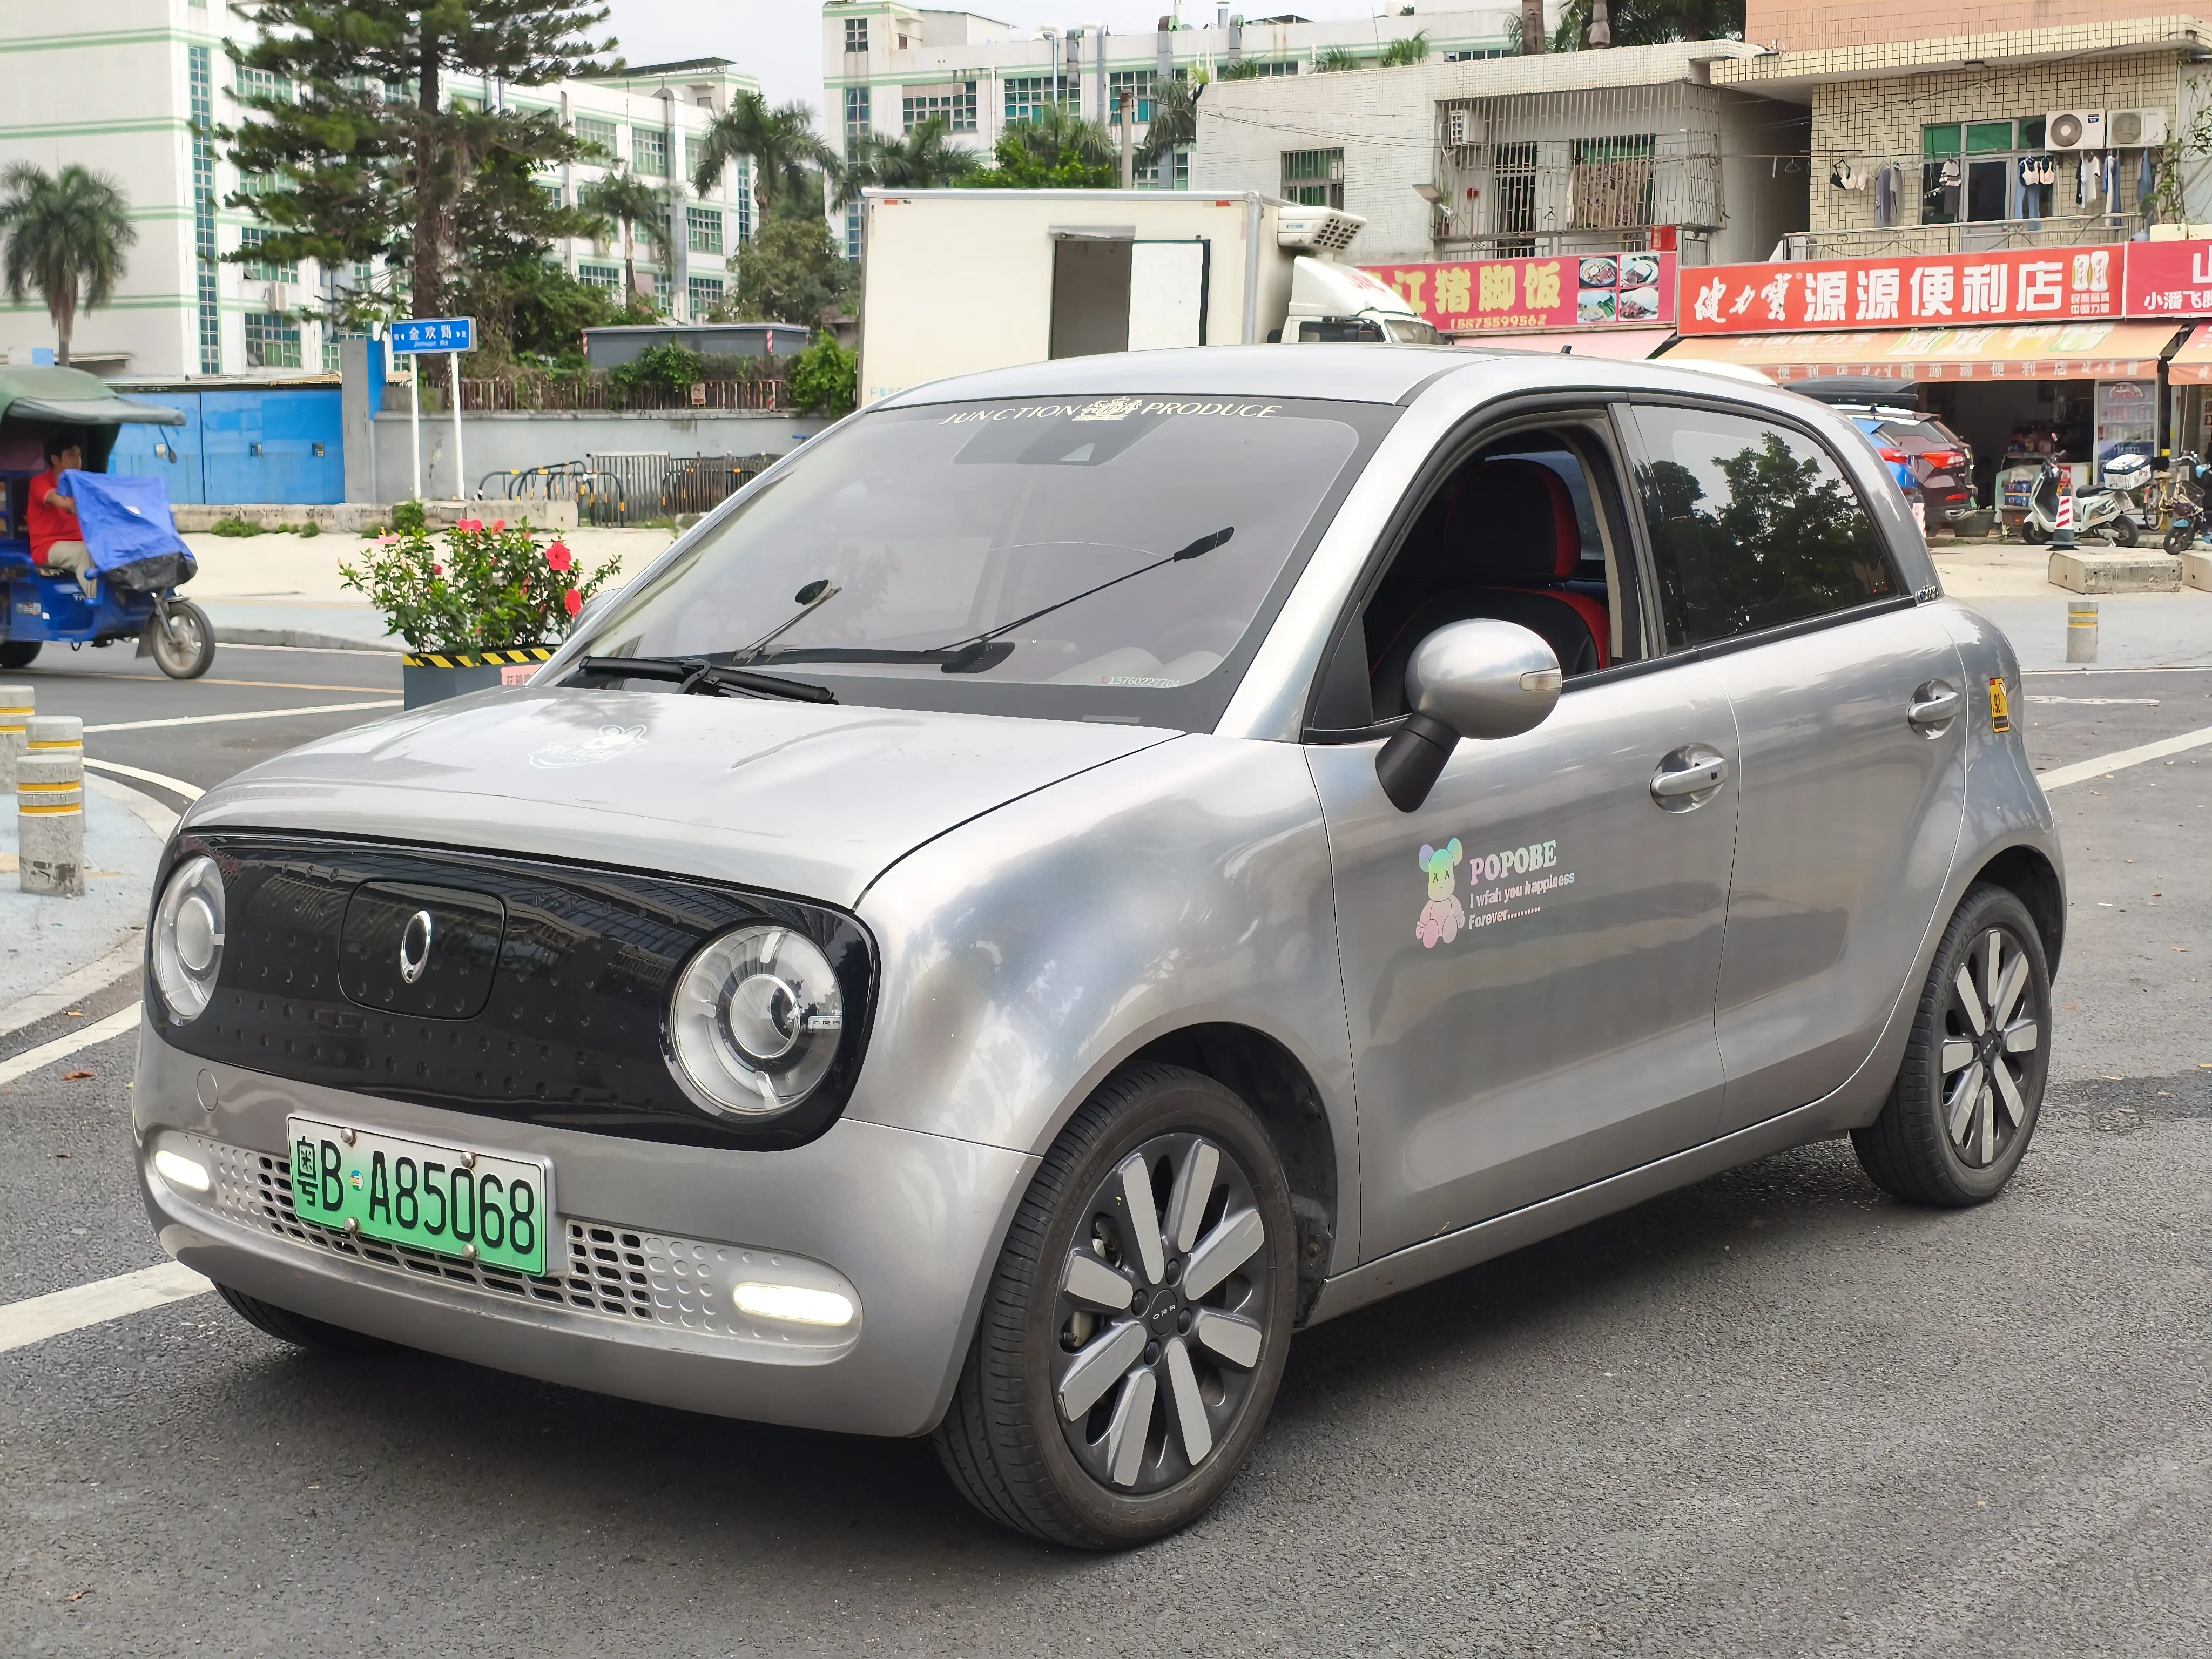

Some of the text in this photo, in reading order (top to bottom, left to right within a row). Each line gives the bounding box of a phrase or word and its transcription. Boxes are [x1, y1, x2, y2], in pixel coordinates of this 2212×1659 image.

[1372, 261, 1561, 314] 江猪脚饭
[1804, 261, 2063, 322] 源源便利店
[939, 402, 1282, 425] JUNCTION PRODUCE
[1469, 840, 1557, 885] POPOBE
[1504, 885, 1522, 903] you
[1152, 1304, 1176, 1319] ORA
